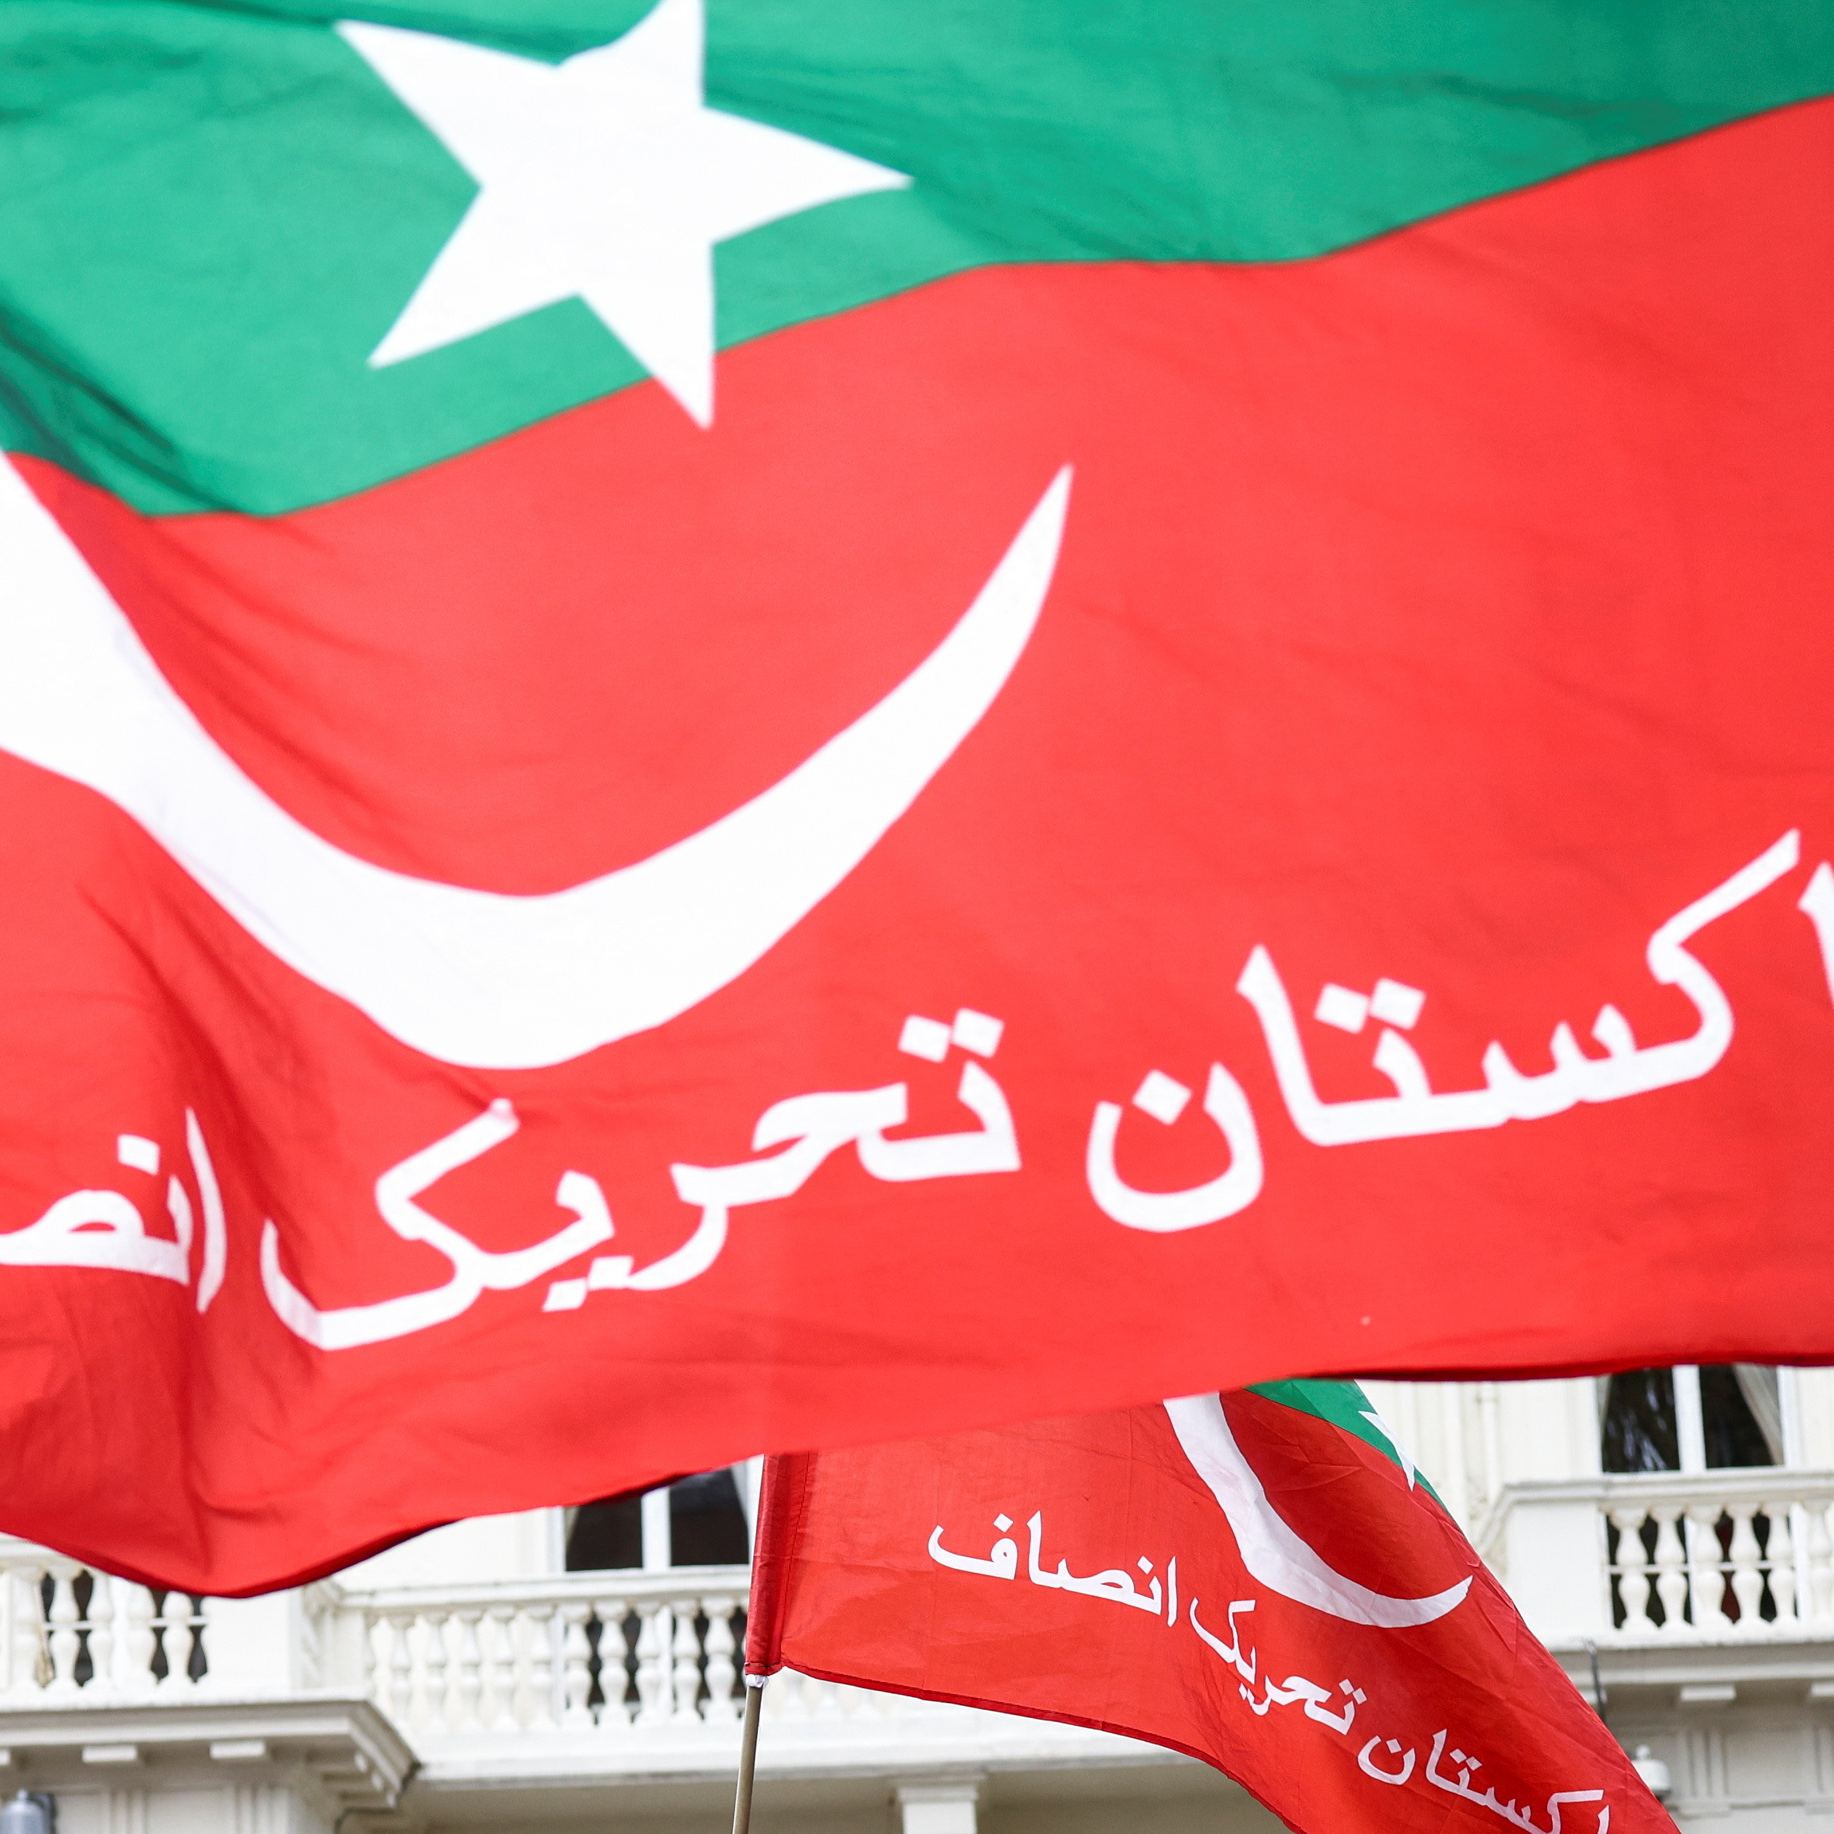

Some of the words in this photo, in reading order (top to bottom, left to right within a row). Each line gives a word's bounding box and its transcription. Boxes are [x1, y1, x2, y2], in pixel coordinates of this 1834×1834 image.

[261, 1008, 1022, 1351] تحریک
[927, 1511, 1178, 1628] انصاف
[1189, 1598, 1367, 1737] تحریک
